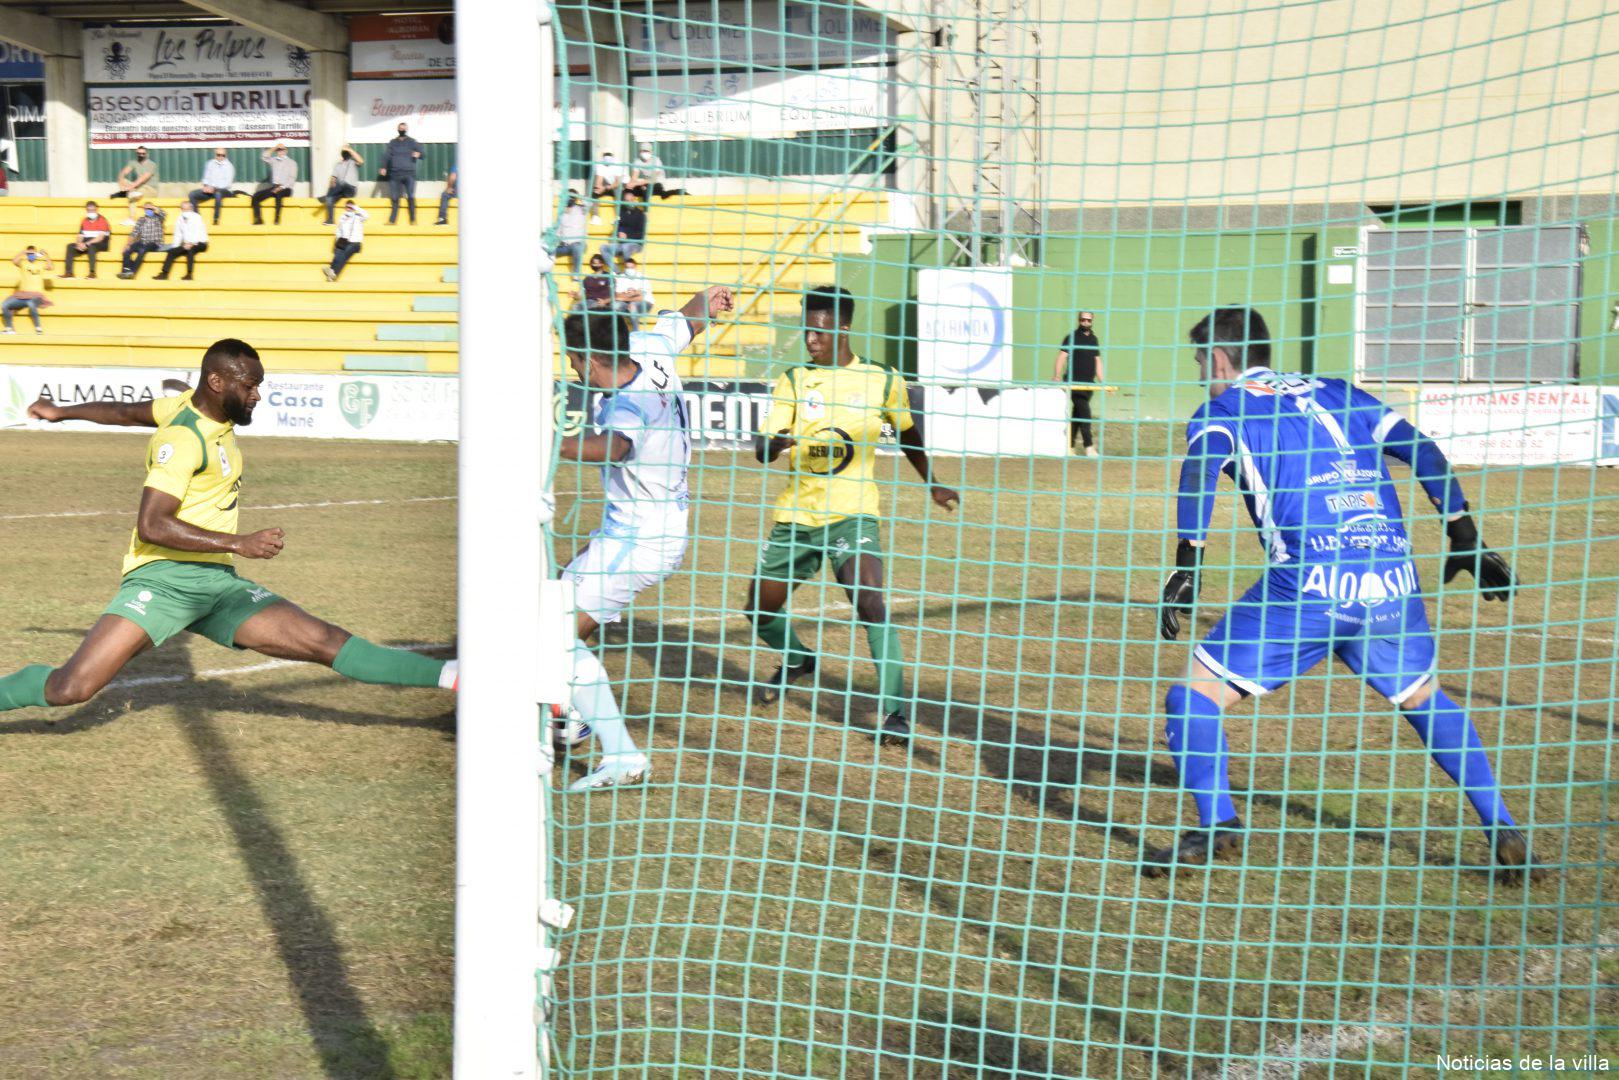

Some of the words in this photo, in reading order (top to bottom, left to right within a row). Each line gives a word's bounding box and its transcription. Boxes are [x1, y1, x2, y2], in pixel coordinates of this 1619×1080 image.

[149, 30, 186, 70] Los
[196, 28, 267, 72] Pulpos
[268, 392, 324, 408] Casa
[1526, 391, 1591, 406] RENTAL
[276, 411, 315, 428] Mané
